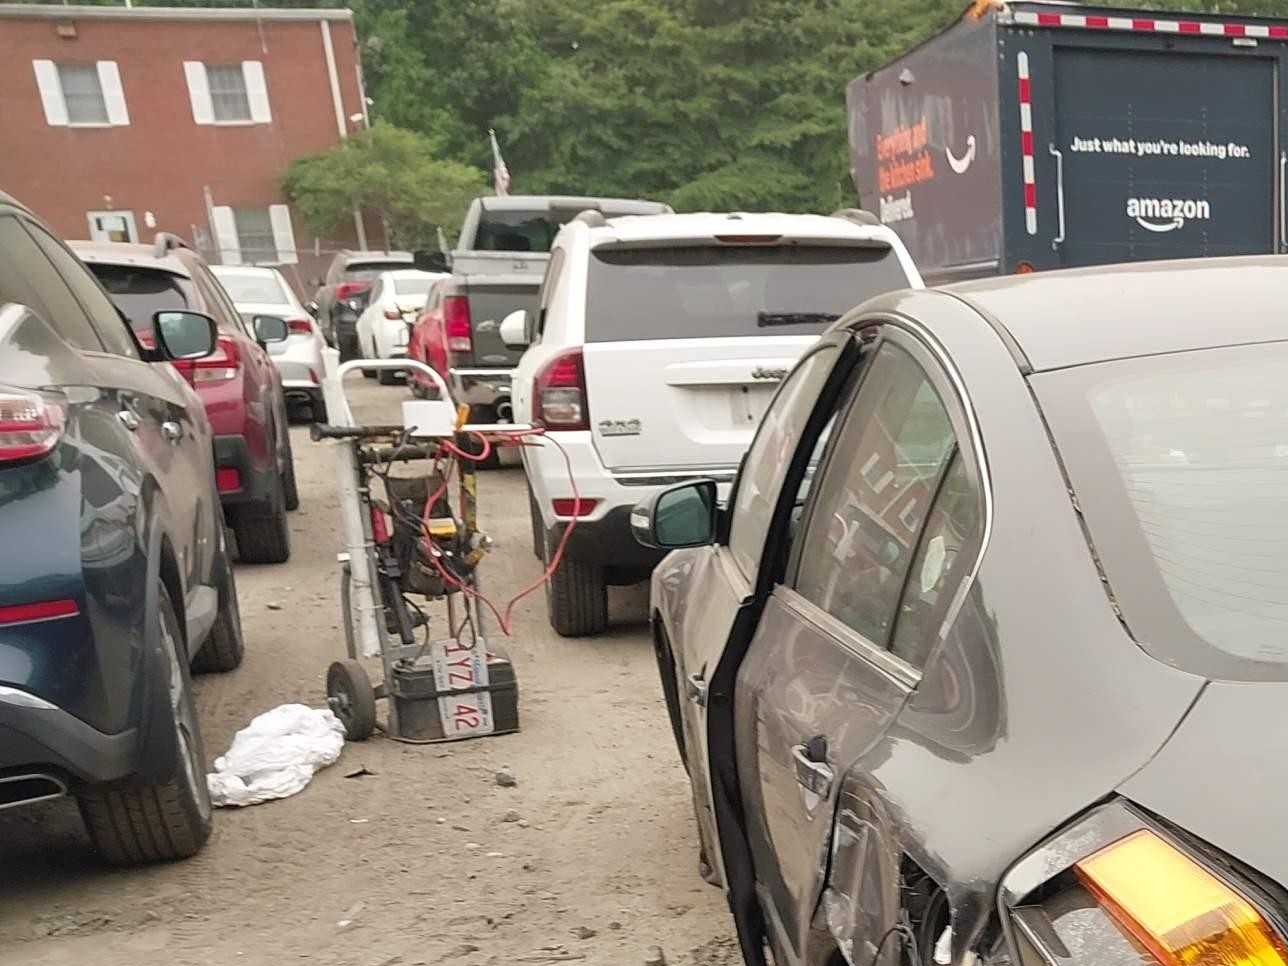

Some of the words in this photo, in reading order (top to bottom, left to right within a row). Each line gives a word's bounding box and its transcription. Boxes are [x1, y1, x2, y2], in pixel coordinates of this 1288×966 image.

[1071, 136, 1101, 152] Just
[1102, 138, 1136, 153] what
[1137, 140, 1178, 156] you're
[1179, 141, 1226, 159] looking
[1227, 143, 1250, 158] for.
[1127, 198, 1210, 219] amazon
[442, 644, 474, 690] 1YZ
